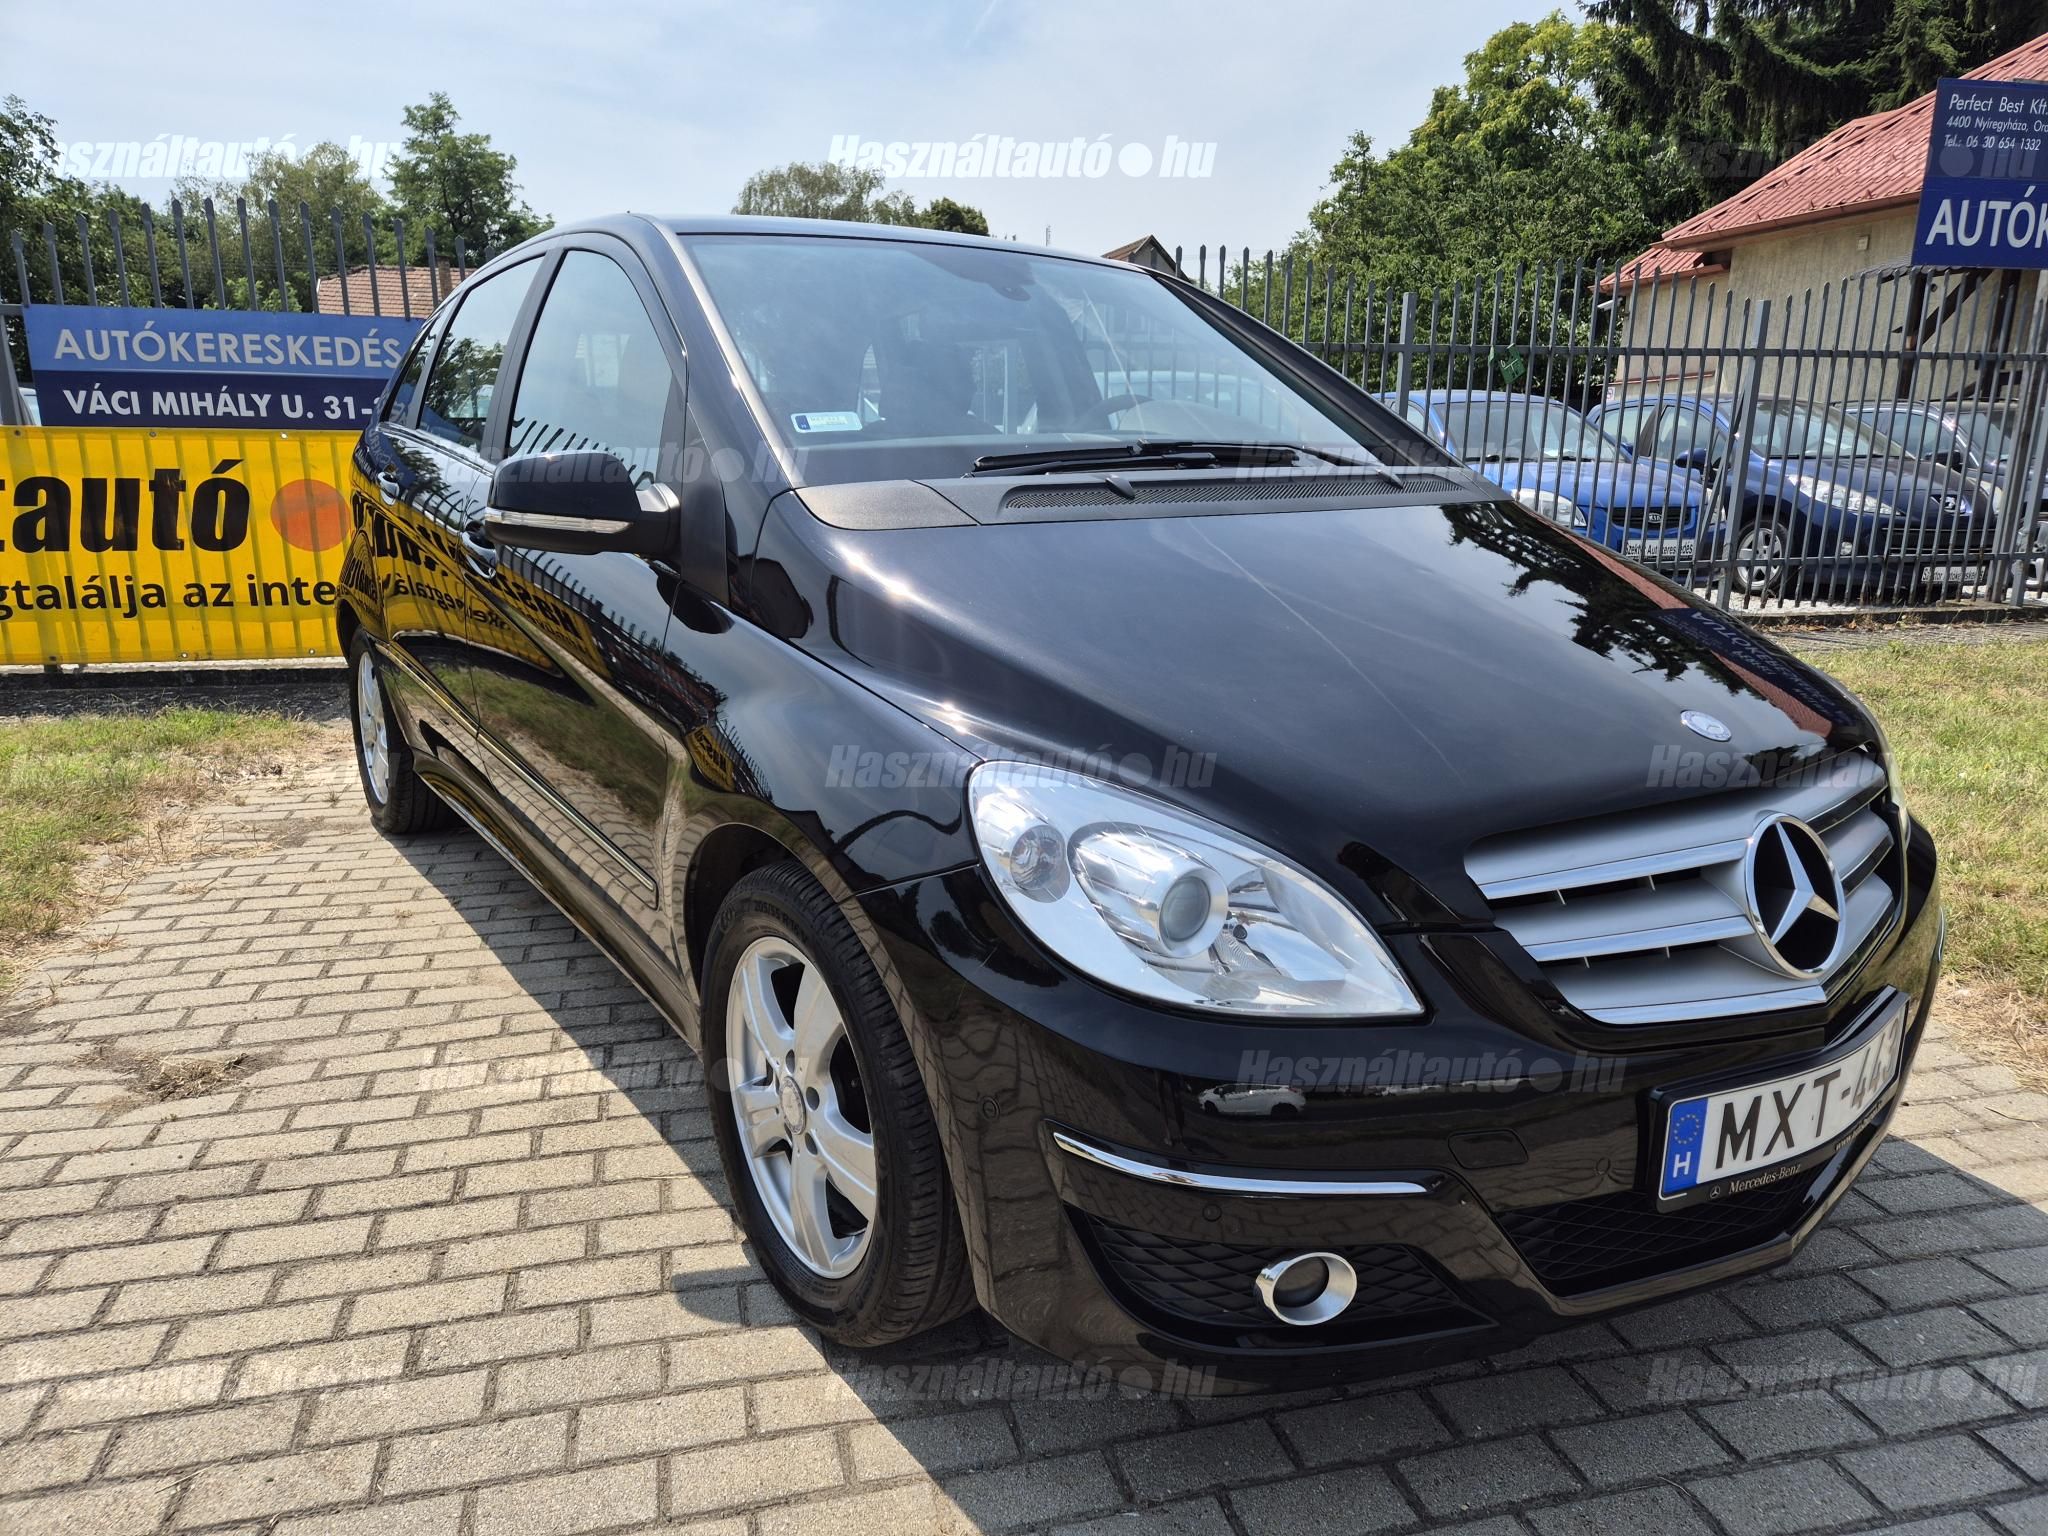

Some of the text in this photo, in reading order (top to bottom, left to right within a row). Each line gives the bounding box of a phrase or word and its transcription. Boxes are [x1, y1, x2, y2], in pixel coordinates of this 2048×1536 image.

[1949, 93, 1993, 111] Perfect
[1998, 96, 2024, 113] Best
[1946, 115, 1971, 128] 4400
[1965, 135, 1979, 148] 06
[1982, 135, 1995, 149] 30
[1998, 136, 2016, 149] 654
[2020, 137, 2042, 151] 1332
[54, 321, 401, 369] AUTÓKERESKEDÉS
[62, 383, 381, 420] VÁCI MIHÁLY U. 31-
[0, 459, 250, 553] autó
[183, 582, 234, 608] az
[1673, 1151, 1692, 1178] H
[1728, 1164, 1801, 1195] Mercedes-Benz
